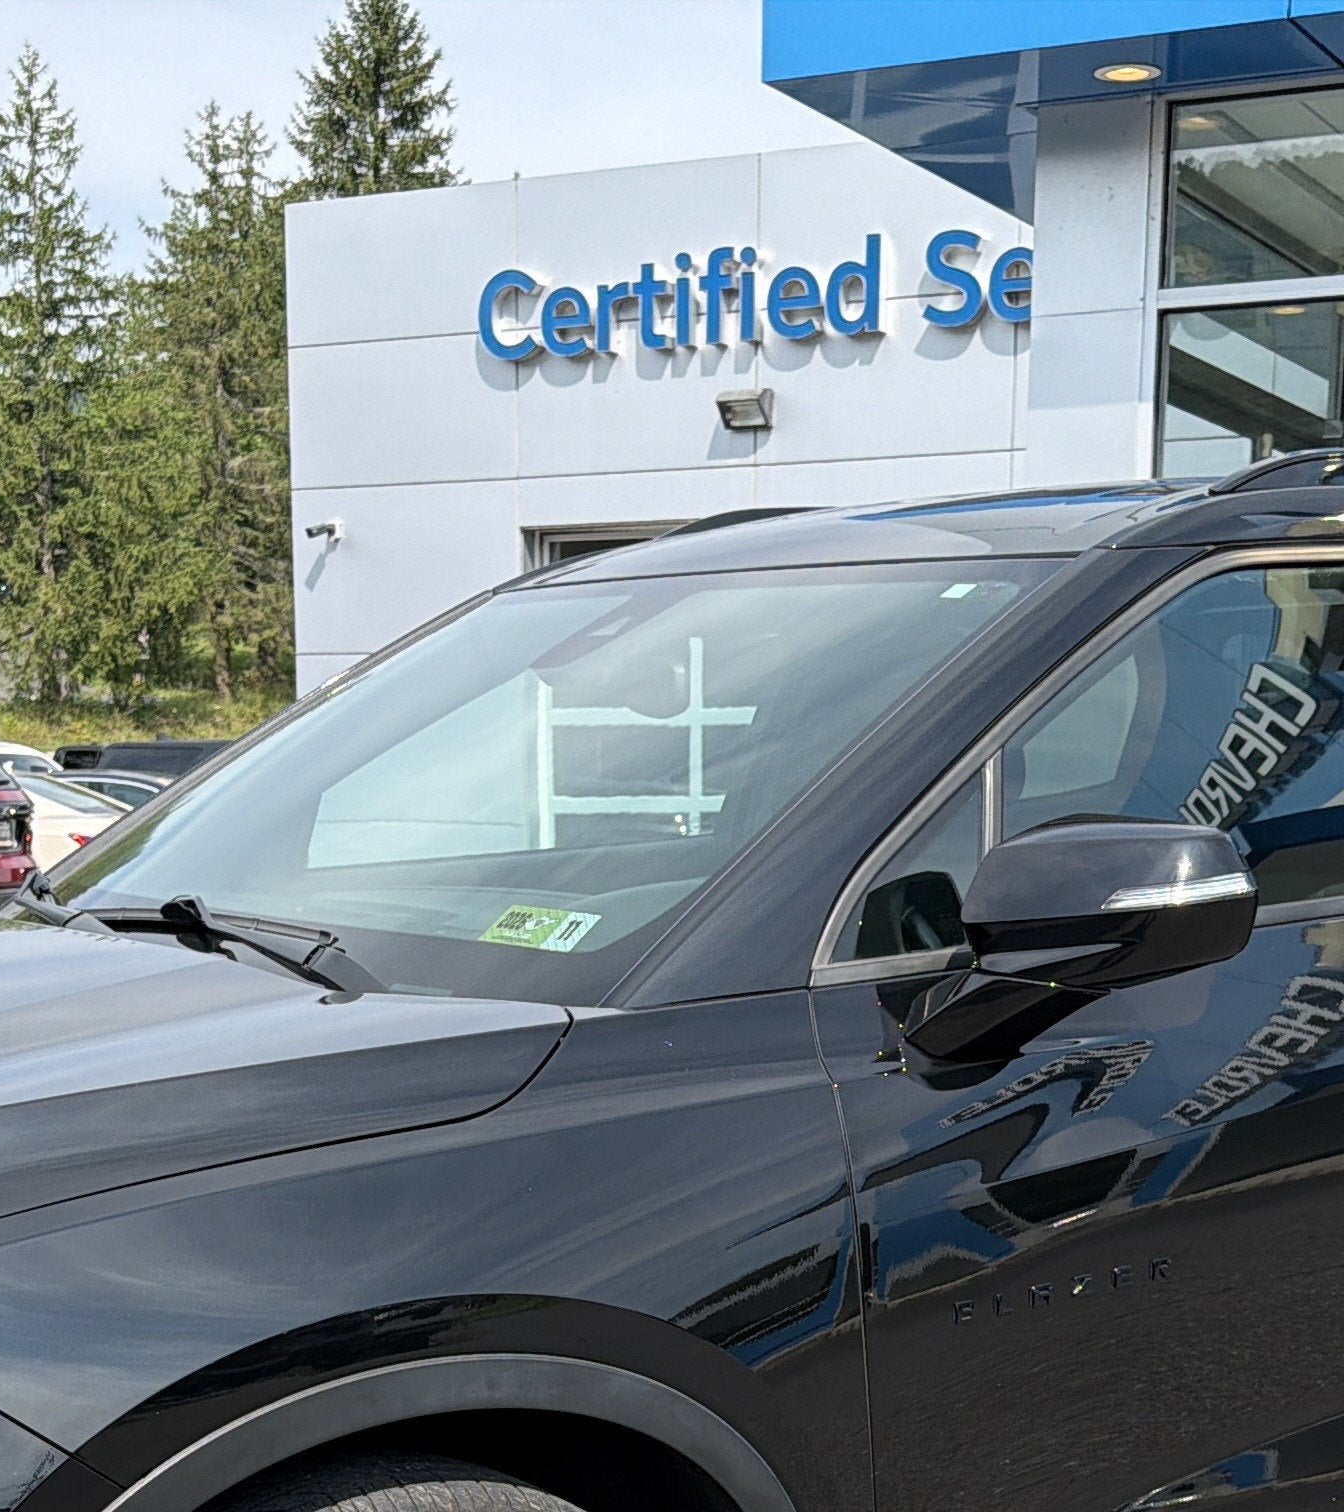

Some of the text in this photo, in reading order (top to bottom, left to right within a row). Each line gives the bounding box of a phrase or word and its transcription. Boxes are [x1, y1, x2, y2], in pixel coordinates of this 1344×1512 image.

[479, 229, 1032, 361] Certified Se
[952, 1256, 1173, 1325] BLAZER
